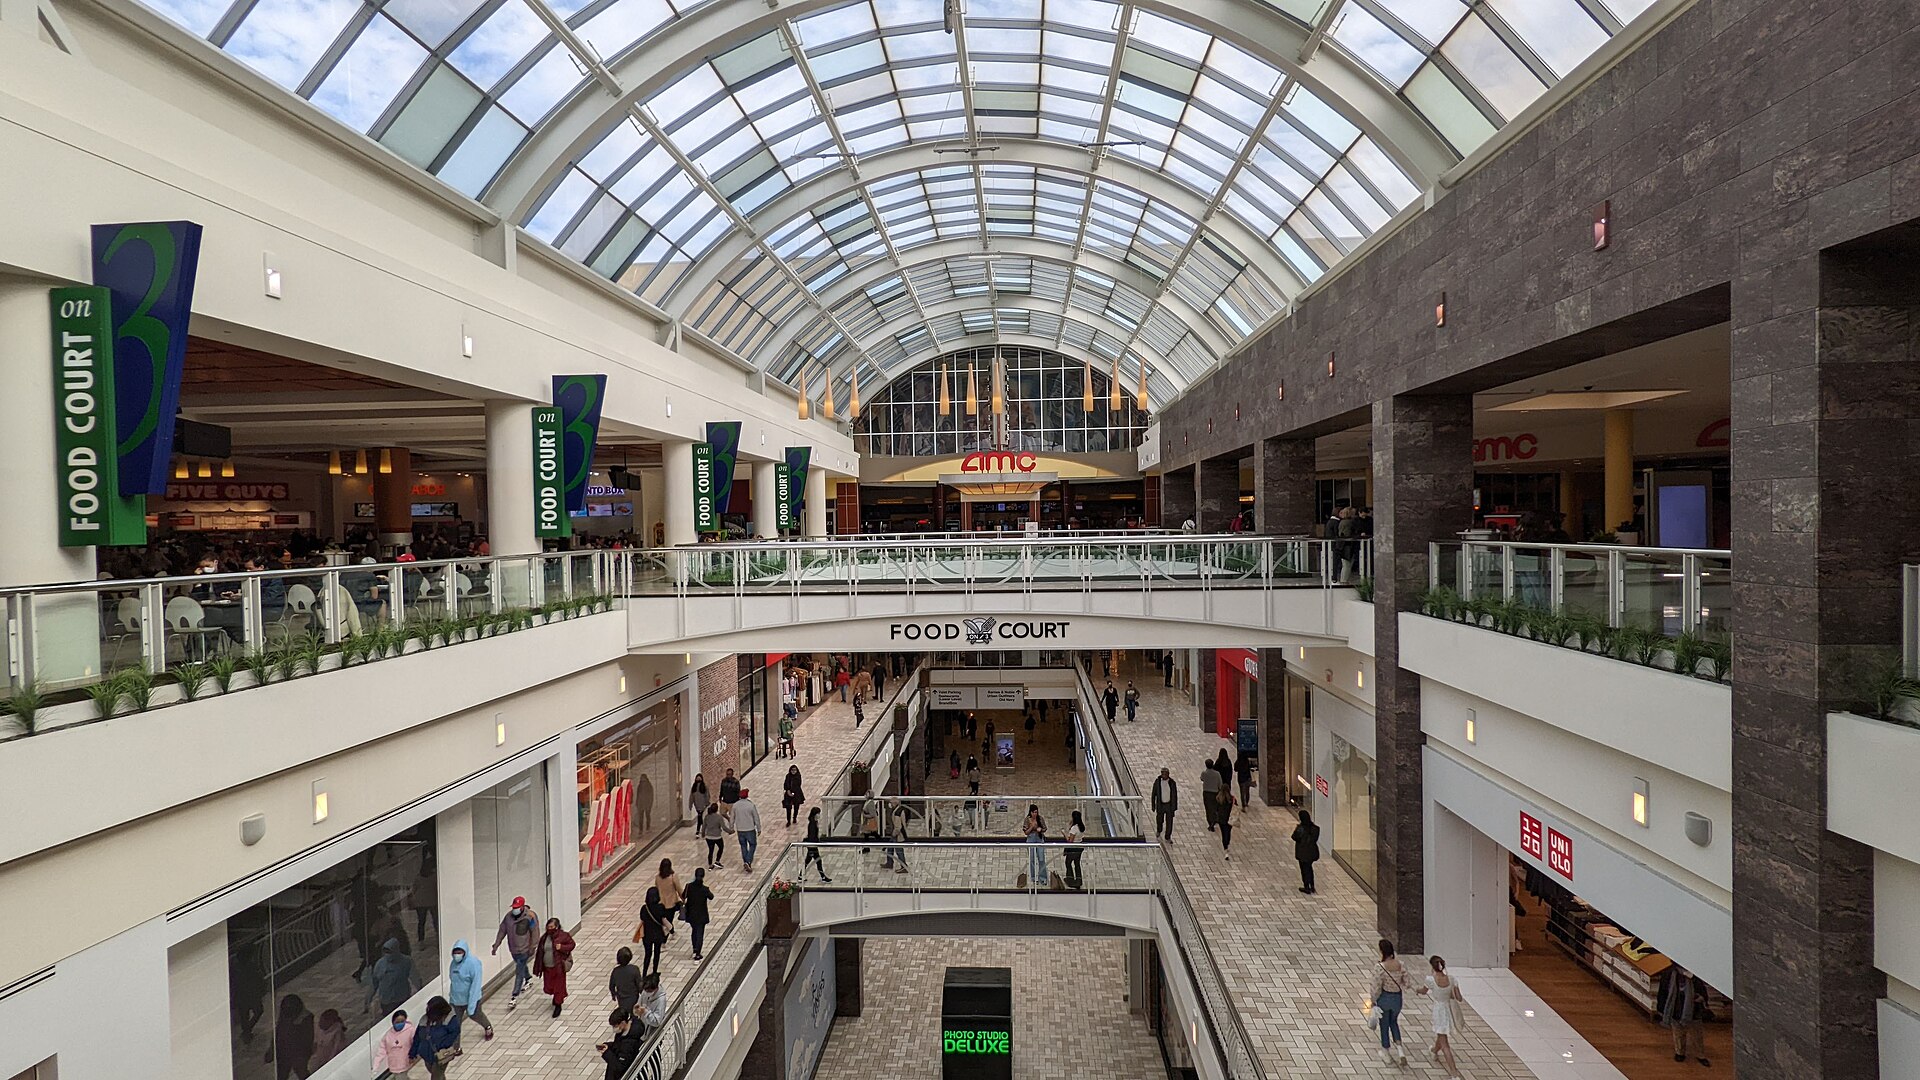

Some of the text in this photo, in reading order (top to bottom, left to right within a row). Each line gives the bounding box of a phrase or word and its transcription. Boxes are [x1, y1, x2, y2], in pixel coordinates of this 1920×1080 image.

[60, 299, 92, 319] on
[538, 413, 556, 423] on
[62, 331, 100, 532] FOOD COURT
[697, 447, 709, 455] on
[539, 429, 558, 530] FOOD COURT
[166, 484, 287, 499] FIVE GUYS
[586, 486, 605, 495] NTO
[697, 458, 711, 526] FOOD COURT
[778, 474, 789, 525] FOOD COURT
[890, 622, 1070, 640] FOOD COURT
[944, 1030, 1009, 1040] PHOTO STUDIO
[944, 1039, 1009, 1053] DELUXE
